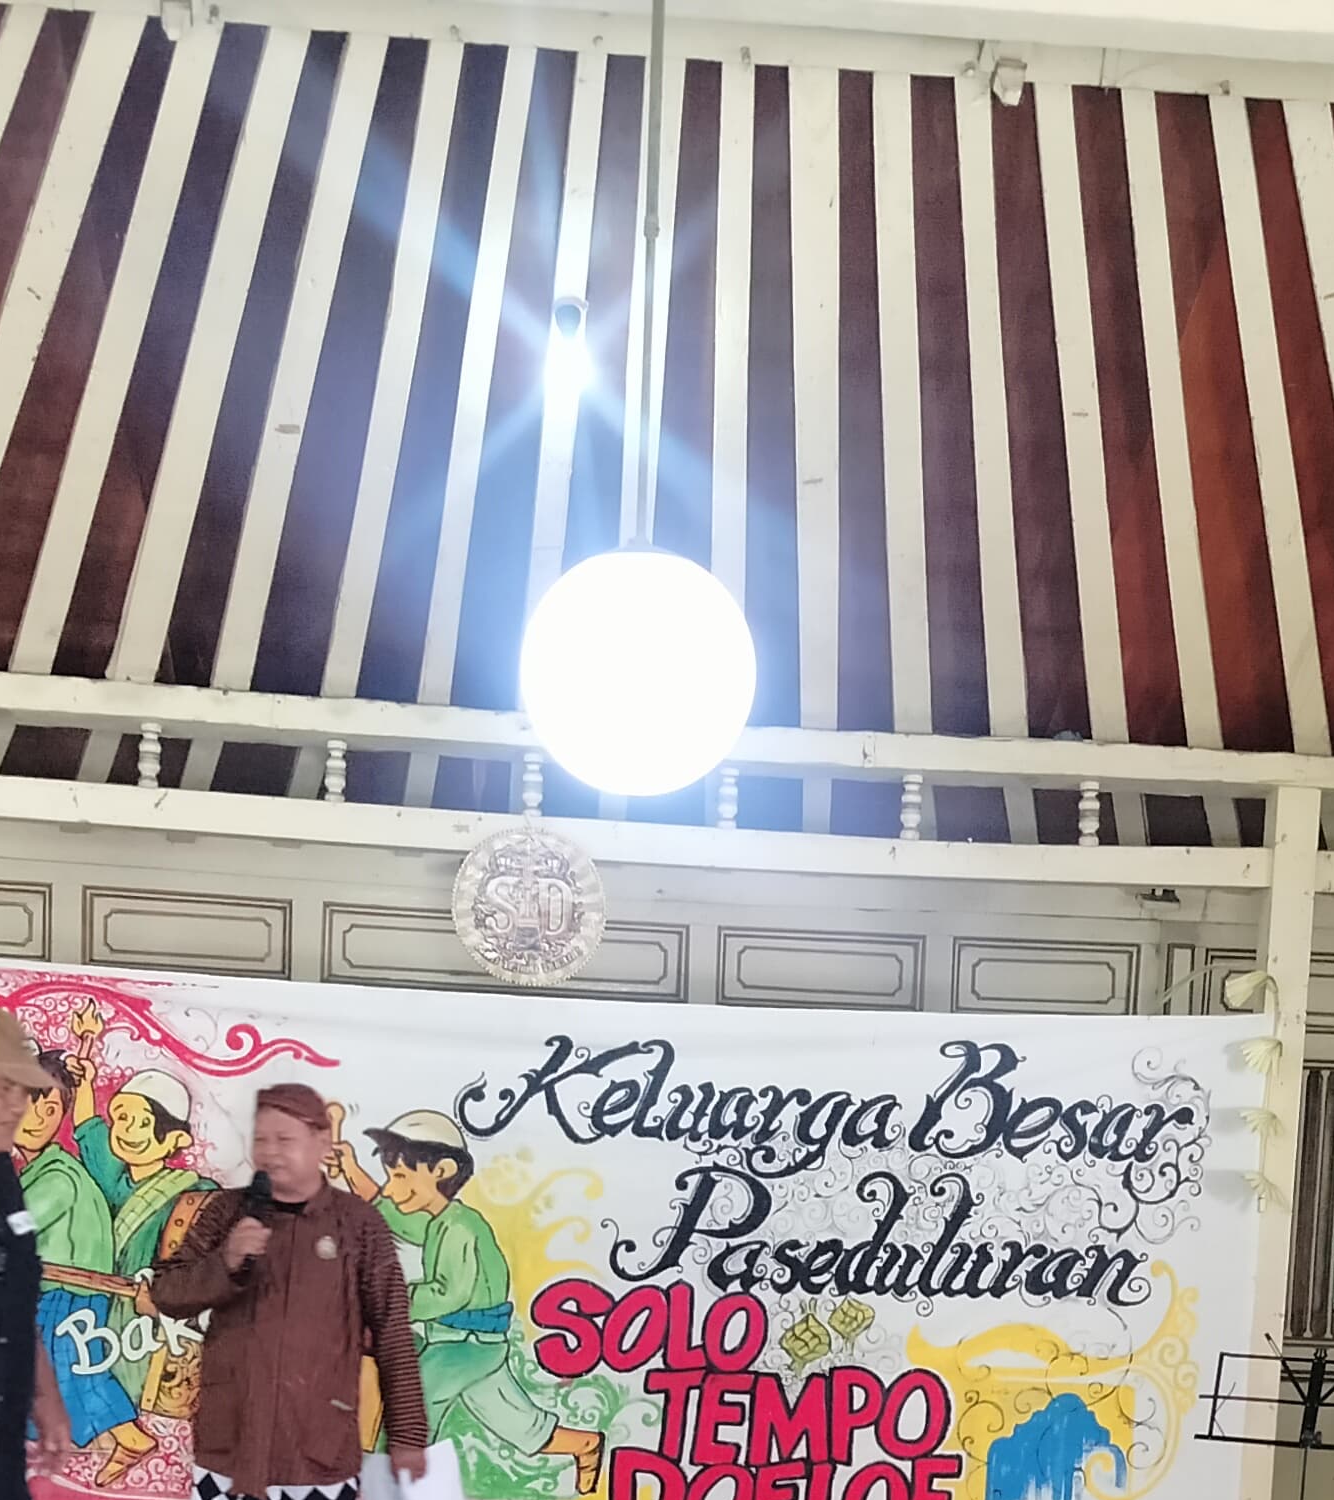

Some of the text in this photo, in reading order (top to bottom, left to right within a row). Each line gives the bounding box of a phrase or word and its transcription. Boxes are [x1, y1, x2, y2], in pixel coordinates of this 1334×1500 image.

[456, 1034, 1197, 1176] Keluarga Besar
[603, 1163, 1151, 1310] Paseduluran
[530, 1279, 769, 1378] SOLO
[646, 1365, 960, 1470] TEMPO
